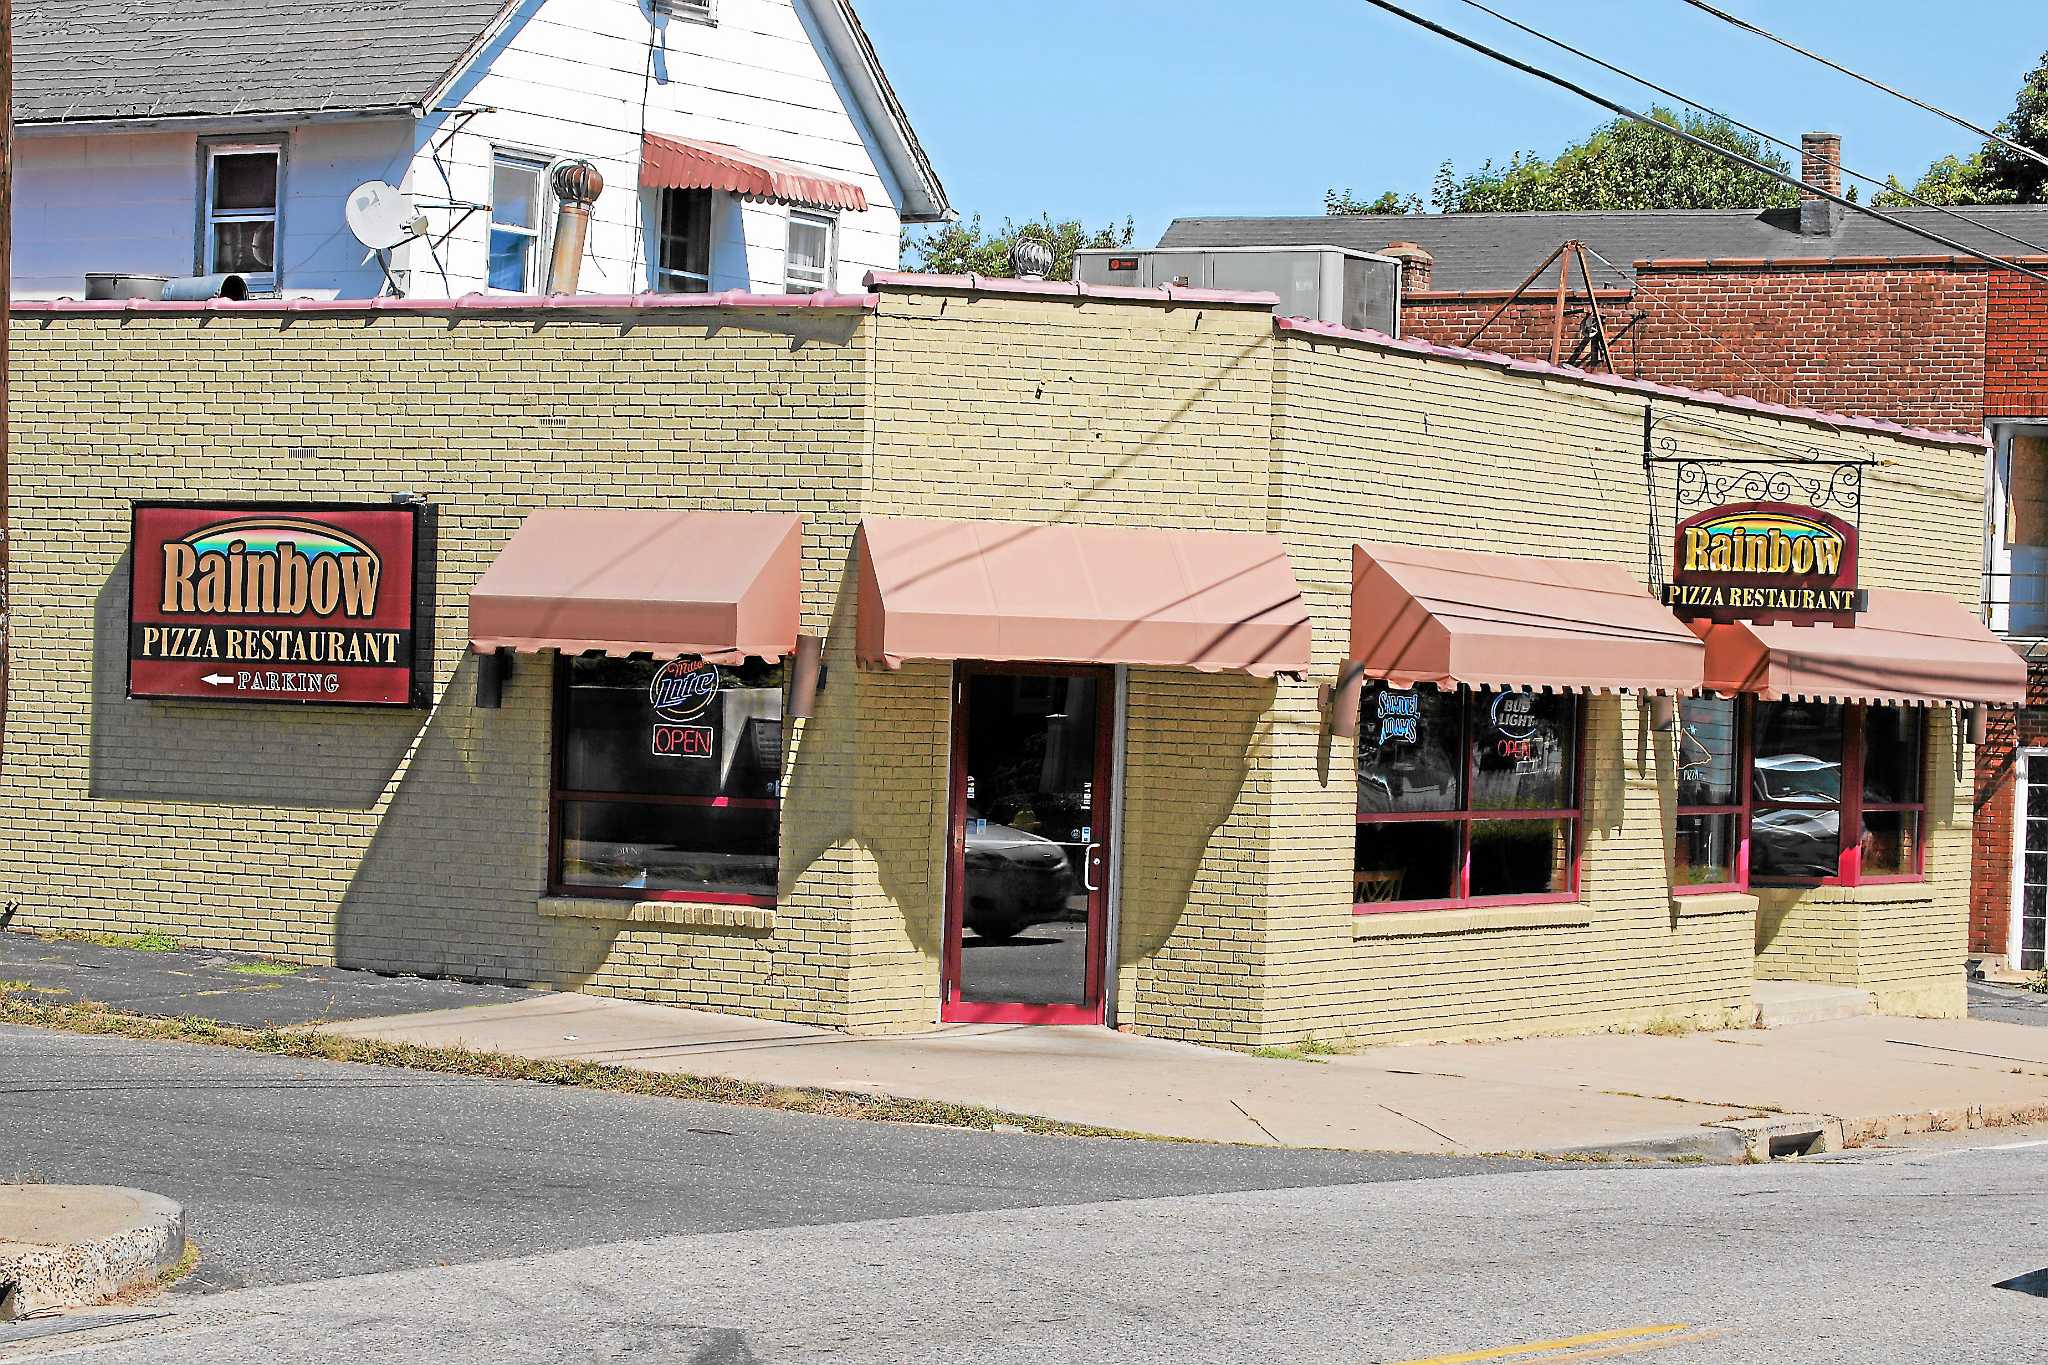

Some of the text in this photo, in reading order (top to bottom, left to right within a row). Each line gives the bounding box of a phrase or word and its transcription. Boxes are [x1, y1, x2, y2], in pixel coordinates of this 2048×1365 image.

[1684, 527, 1843, 575] Rainbow
[162, 539, 379, 616] Rainbow
[1668, 585, 1856, 610] PIZZA RESTAURANT
[142, 626, 400, 663] PIZZA RESTAURANT
[237, 671, 340, 692] PARKING
[654, 672, 715, 708] Lite
[1378, 690, 1420, 719] SAMUEL
[1503, 699, 1531, 713] BUD
[1498, 713, 1535, 727] LIGHT
[656, 728, 710, 753] OPEN
[1497, 739, 1531, 758] OPEN
